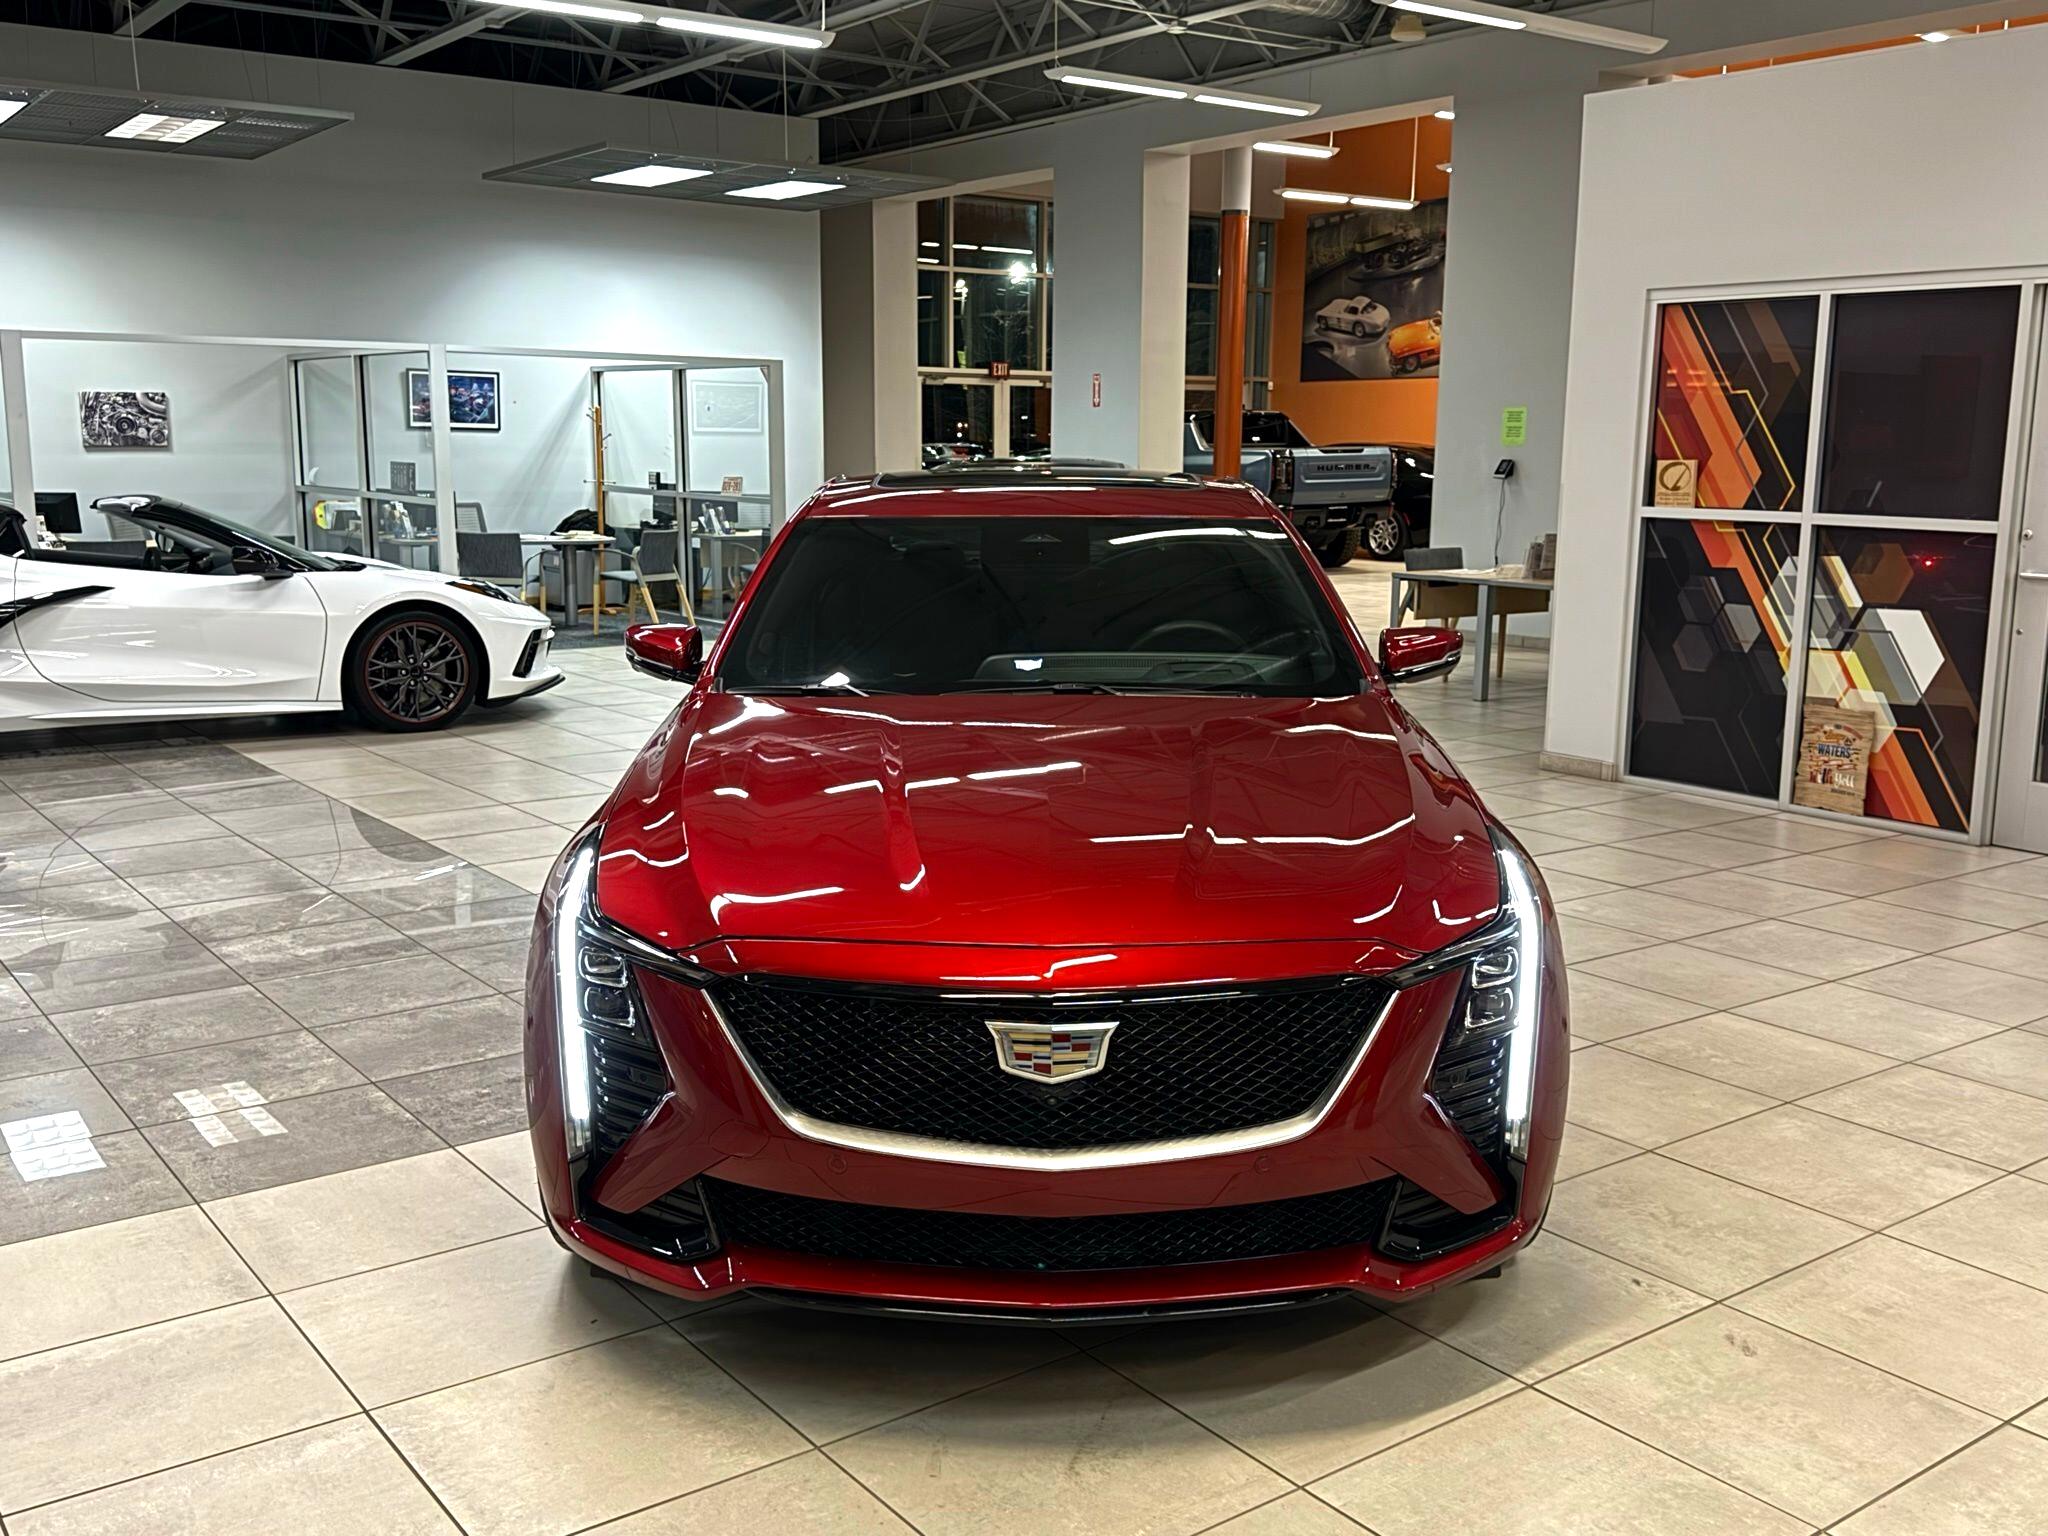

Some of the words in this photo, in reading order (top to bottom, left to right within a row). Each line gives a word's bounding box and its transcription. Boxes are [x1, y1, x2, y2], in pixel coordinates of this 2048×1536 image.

[993, 363, 1008, 376] EXIT
[1317, 464, 1370, 472] HUMMER
[1818, 744, 1851, 758] WATERS
